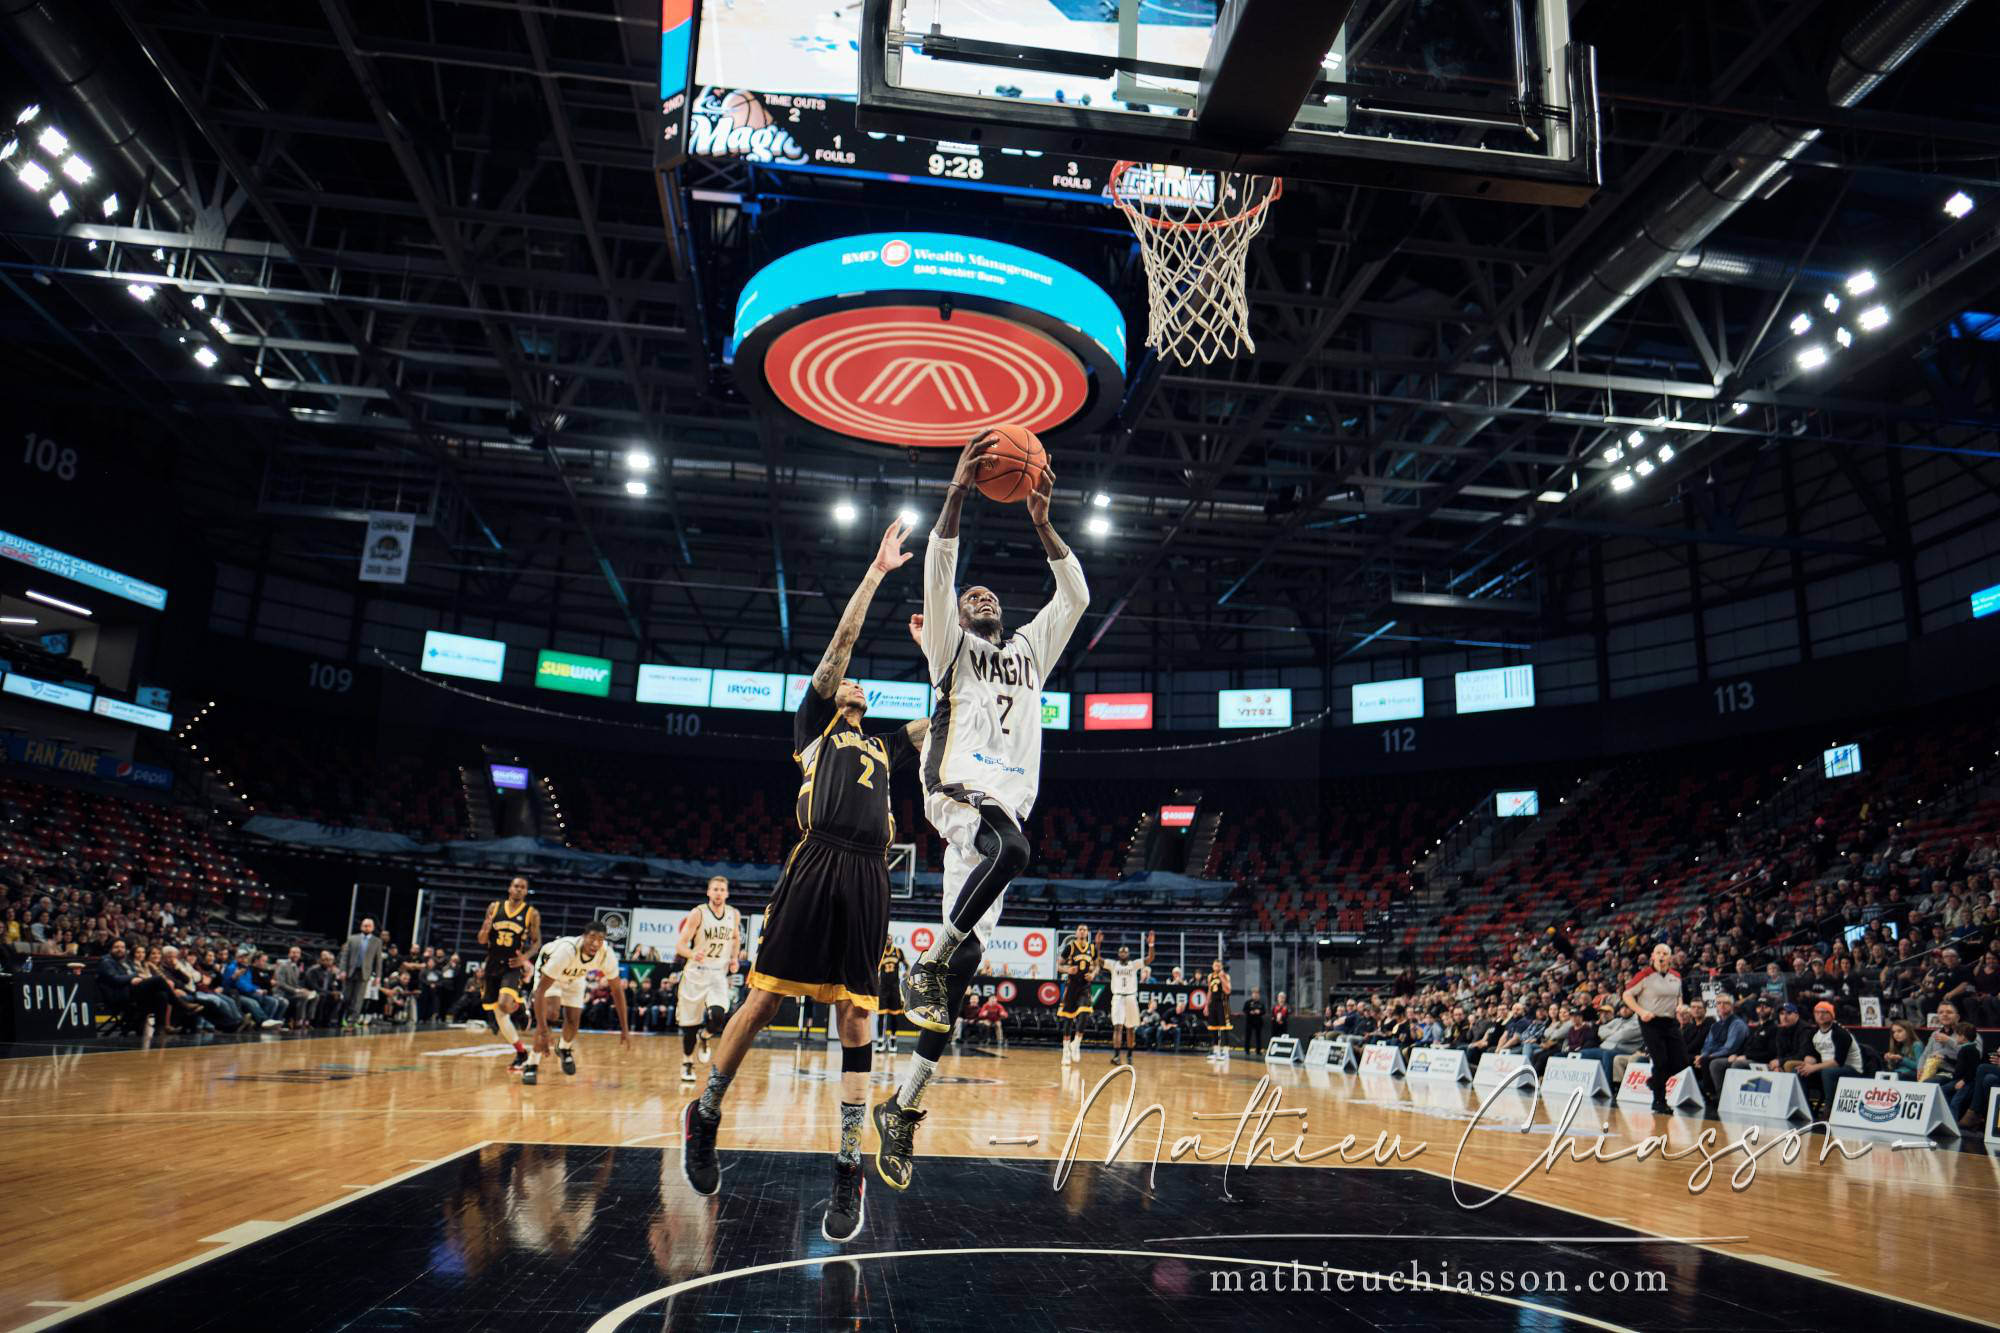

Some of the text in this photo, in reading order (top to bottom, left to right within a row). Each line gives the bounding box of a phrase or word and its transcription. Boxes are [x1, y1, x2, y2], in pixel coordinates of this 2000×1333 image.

[764, 94, 826, 113] TIME OUTS
[788, 107, 801, 122] 2
[688, 114, 810, 165] Magic
[832, 134, 842, 150] 1
[815, 147, 856, 165] FOULS
[927, 153, 985, 180] 9:28
[1066, 161, 1079, 176] 3
[1053, 174, 1092, 191] FOULS
[841, 248, 1053, 286] BMO Wealth Management
[24, 431, 79, 481] 108
[5, 536, 125, 585] BUICK GMC CADILLAC
[38, 557, 78, 577] GIANT
[308, 660, 353, 693] 109
[539, 661, 609, 683] SUBWAY
[969, 649, 1034, 691] MAGIC
[727, 684, 772, 698] IRVING
[1712, 681, 1755, 714] 113
[665, 711, 700, 738] 110
[1383, 728, 1415, 753] 112
[24, 735, 98, 775] FAN ZONE
[133, 769, 168, 785] pepsi
[857, 754, 875, 790] 2
[639, 921, 674, 938] BMO
[704, 925, 733, 942] MAGIC
[495, 931, 514, 947] 35
[706, 943, 724, 959] 22
[1138, 991, 1188, 1006] EHAB
[1737, 1093, 1771, 1108] MACC
[1839, 1088, 1862, 1101] LOCALLY
[1864, 1086, 1899, 1103] chris
[1836, 1099, 1858, 1114] MADE
[1900, 1101, 1924, 1121] ICI
